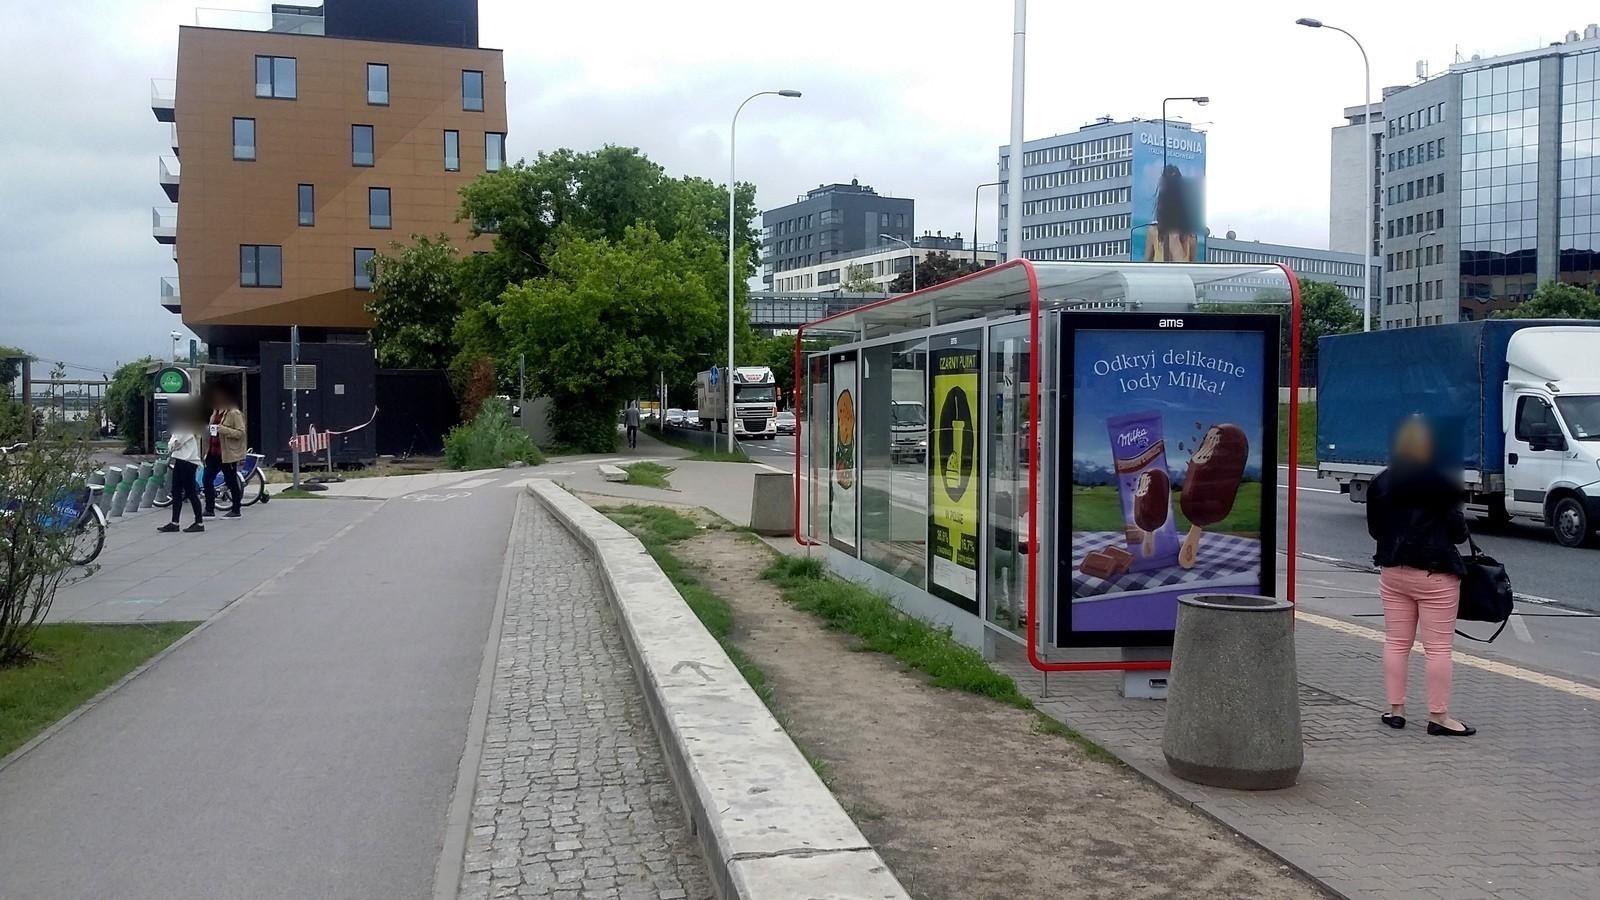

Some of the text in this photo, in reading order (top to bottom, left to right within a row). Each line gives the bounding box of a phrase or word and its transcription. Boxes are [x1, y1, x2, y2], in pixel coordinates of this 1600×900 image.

[1140, 132, 1202, 153] CALZEDONIA
[1159, 319, 1184, 328] ams
[1094, 349, 1245, 378] Odkryj delikatne
[1120, 370, 1226, 395] lody Milka!
[1117, 427, 1149, 447] Milka
